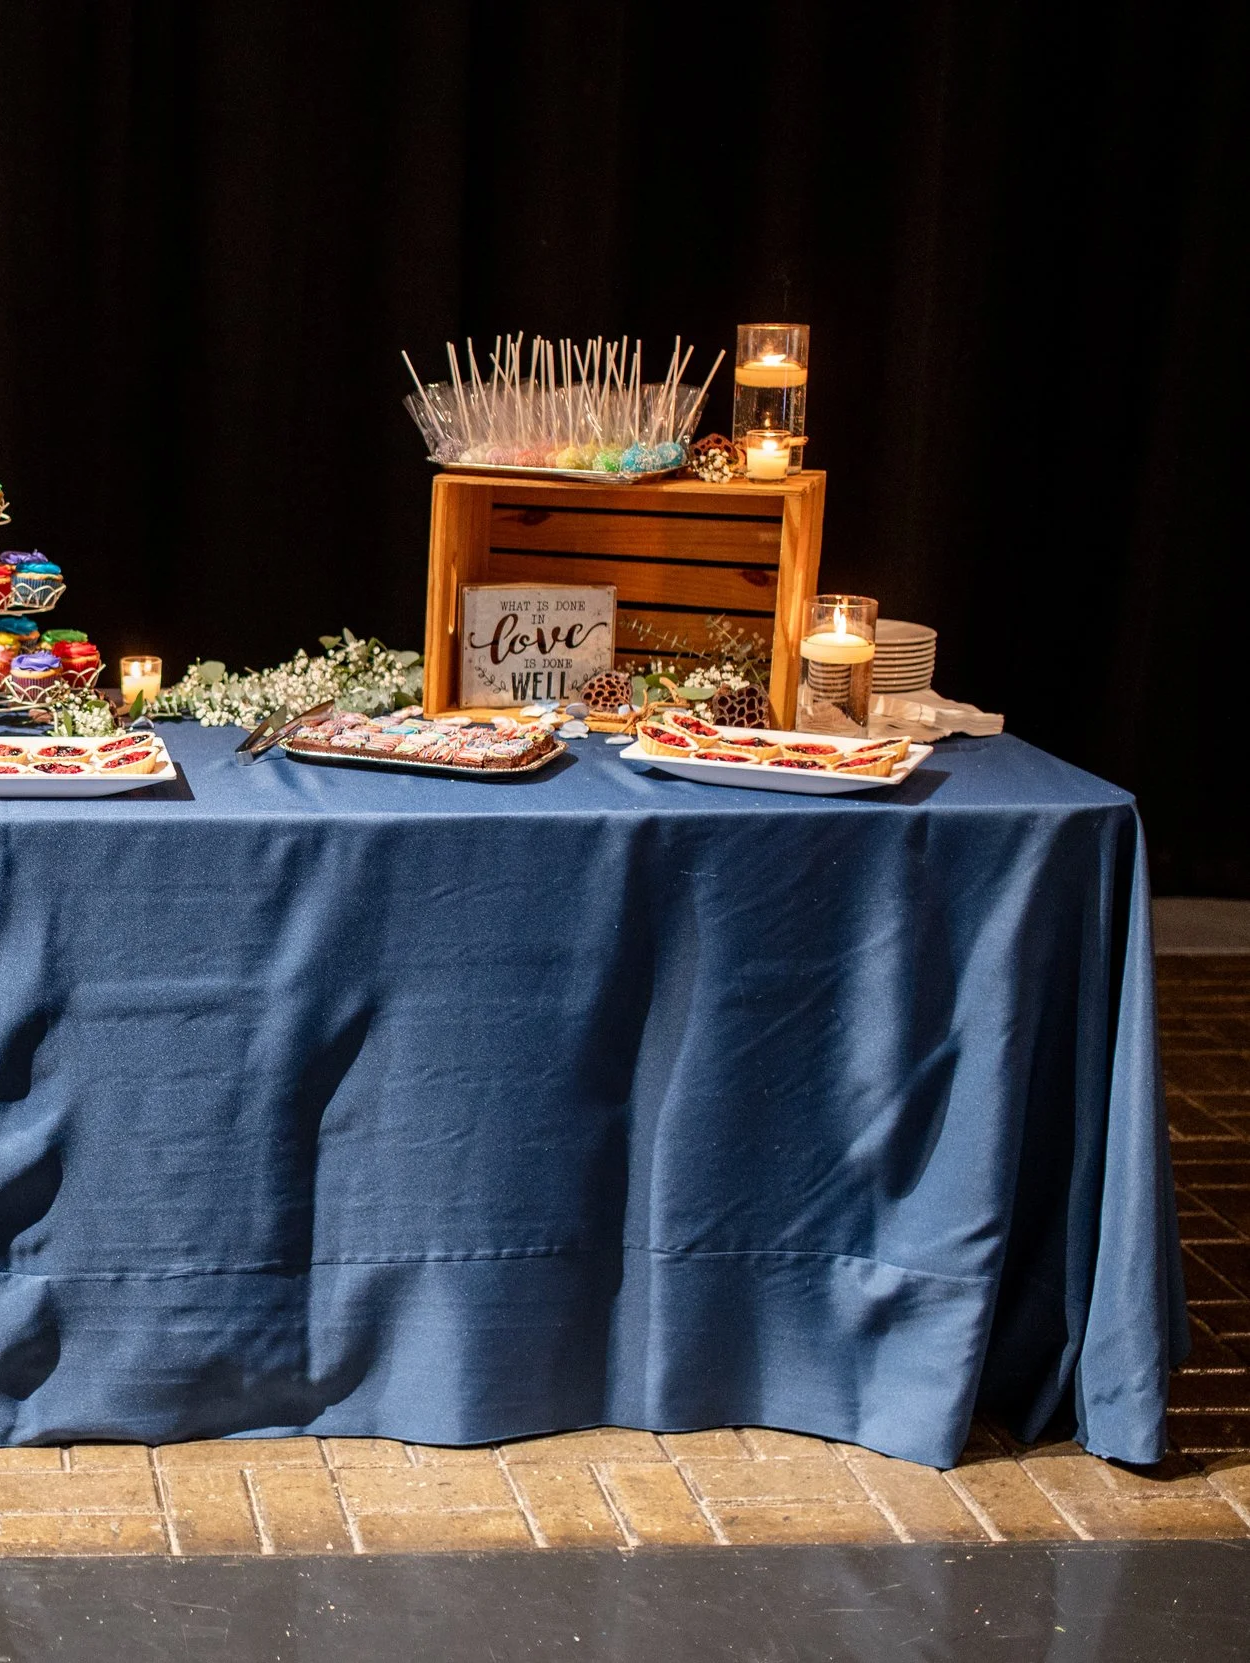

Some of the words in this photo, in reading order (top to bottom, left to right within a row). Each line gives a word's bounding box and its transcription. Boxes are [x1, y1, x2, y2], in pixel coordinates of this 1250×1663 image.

[500, 601, 531, 612] WHAT
[536, 601, 549, 611] IS
[555, 600, 586, 612] DONE
[530, 614, 545, 625] IN
[524, 658, 536, 669] IS
[542, 658, 573, 669] DONE
[511, 671, 570, 701] WELL
